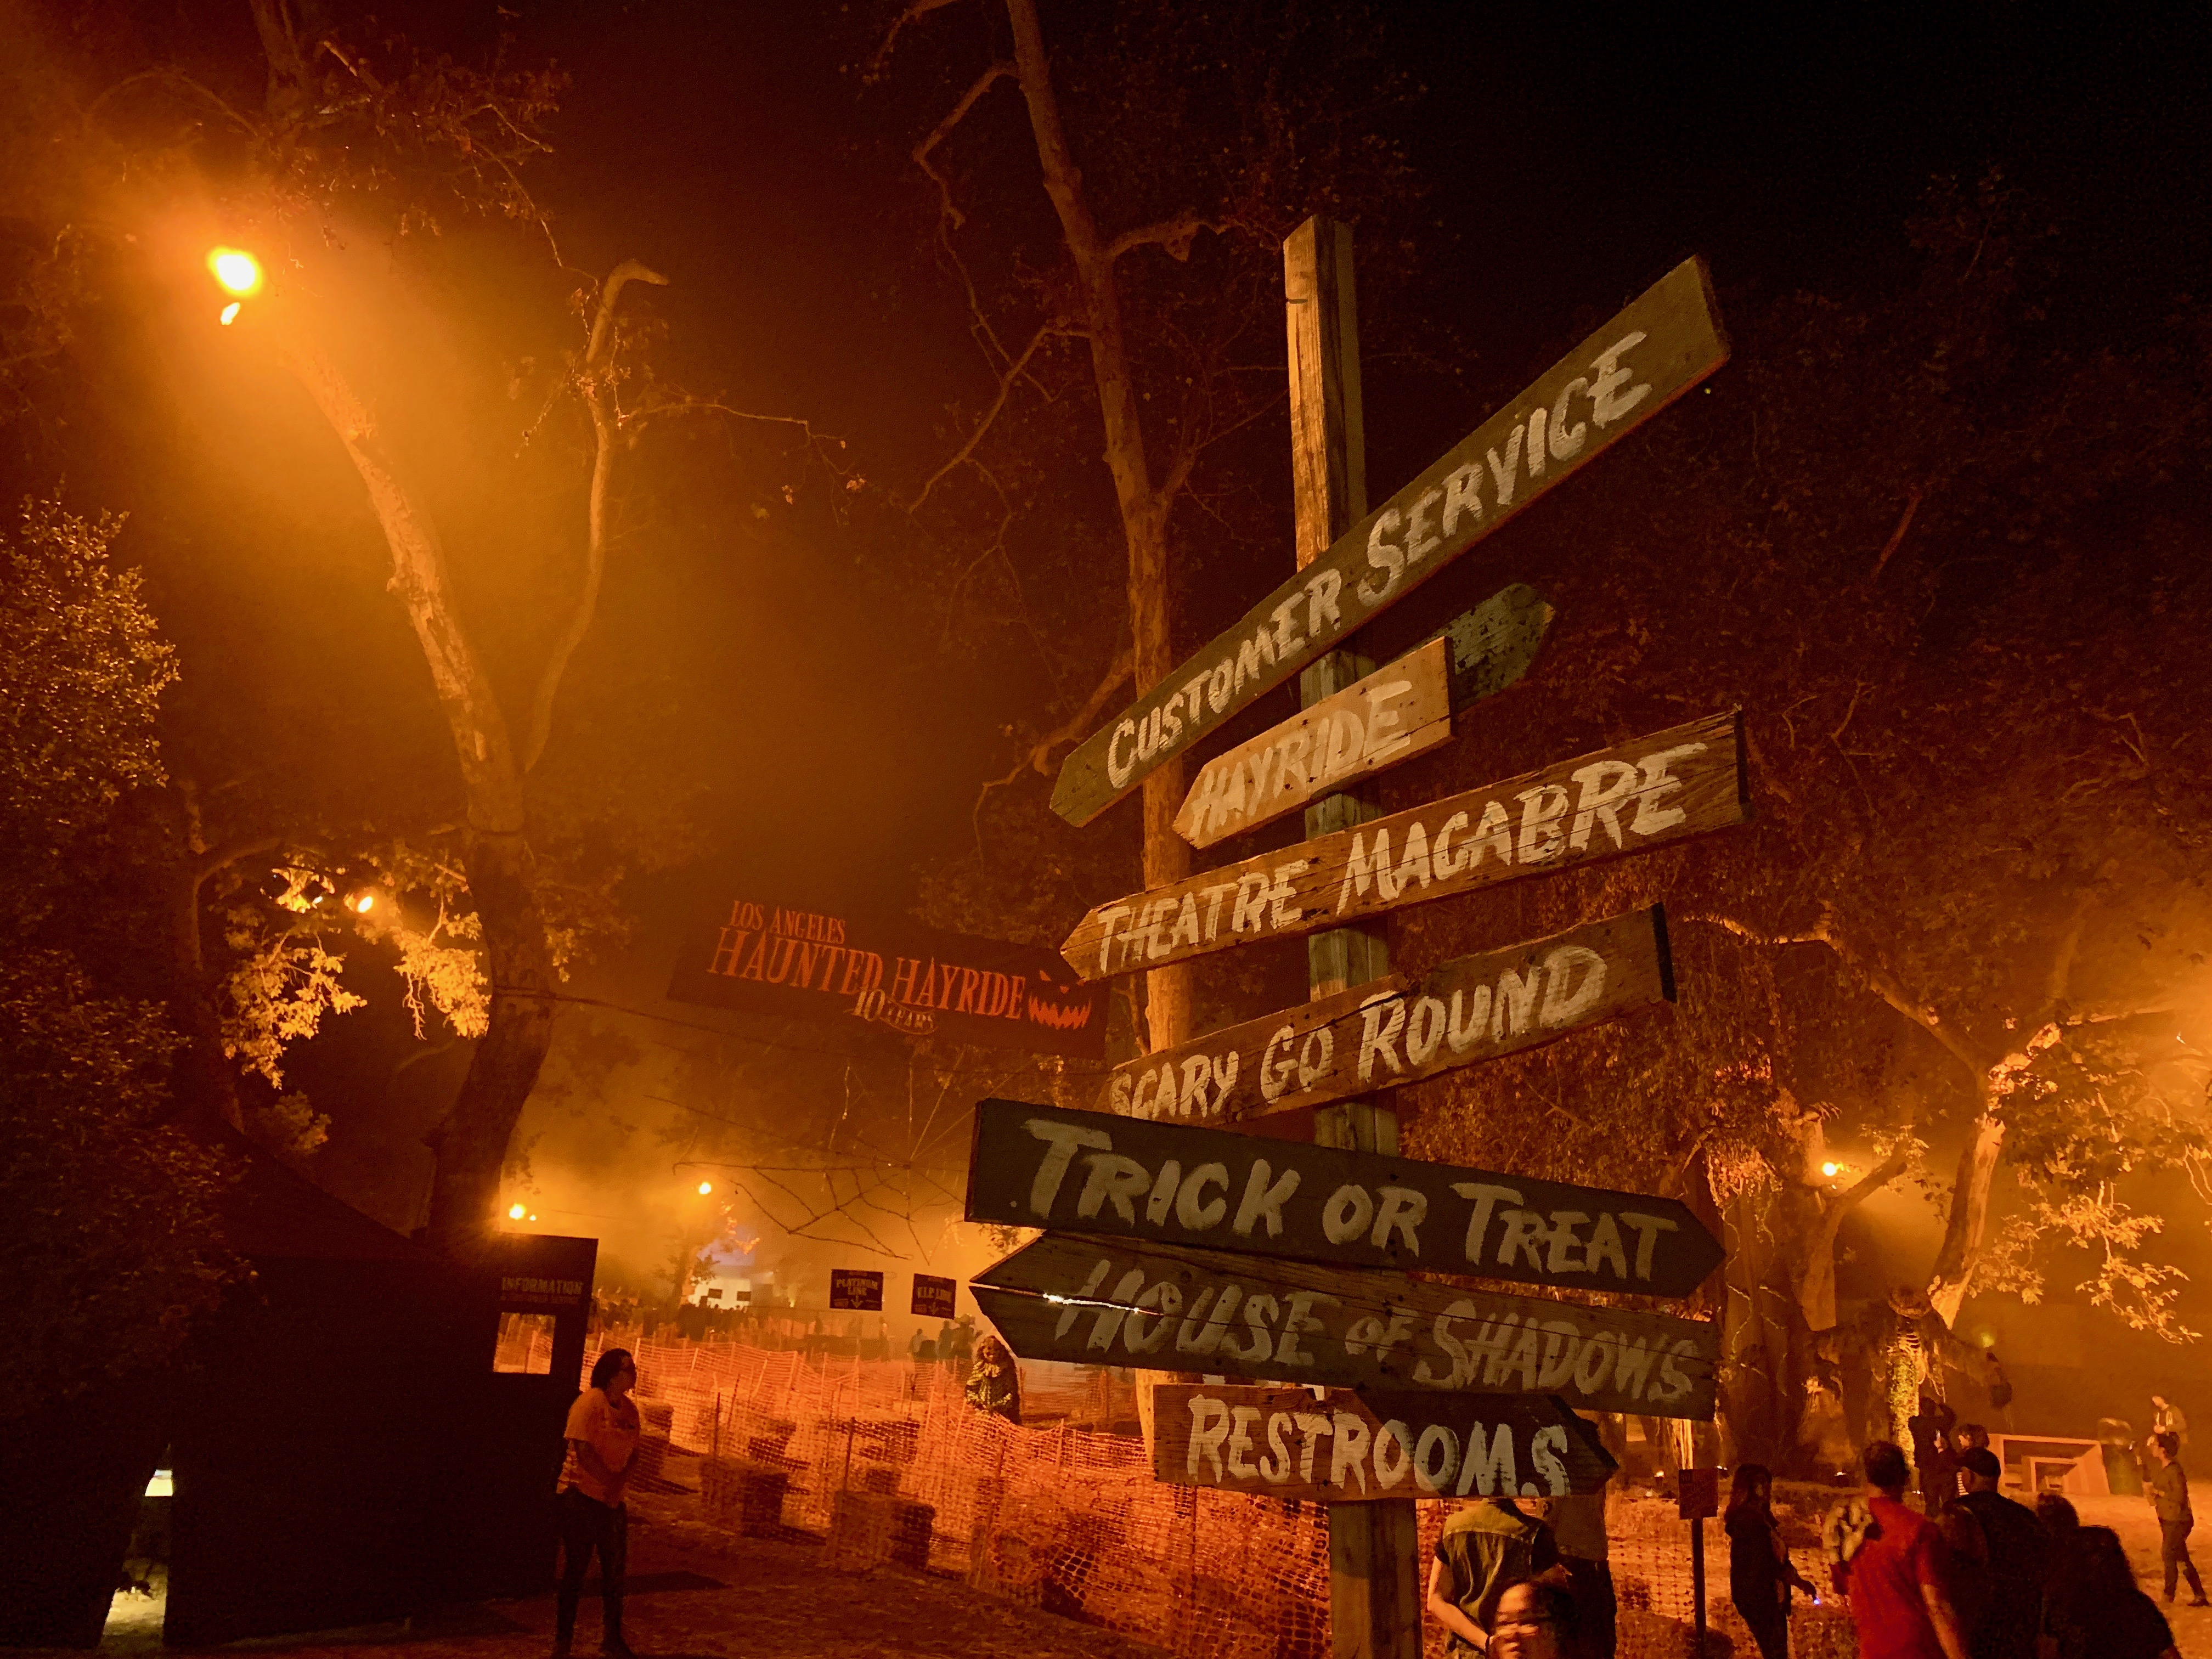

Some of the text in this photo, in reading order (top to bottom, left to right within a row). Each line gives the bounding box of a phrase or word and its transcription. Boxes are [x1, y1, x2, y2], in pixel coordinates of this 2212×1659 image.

[1107, 330, 1652, 788] CUSTOMER SERVICE
[1189, 679, 1413, 838] HAYRIDE
[730, 900, 846, 945] LOS ANGELES
[1096, 742, 1708, 974] THEATRE MACABRE
[706, 927, 1026, 1020] HAUNTED HAYRIDE
[853, 988, 886, 1022] 10
[1109, 945, 1608, 1121] SCARY GO ROUND
[1025, 1118, 1678, 1282] TRICK OR TREAT
[501, 1276, 584, 1295] INFORMATION
[1053, 1258, 1341, 1367] HOUSE
[1413, 1298, 1699, 1404] SHADOWS
[1187, 1392, 1570, 1497] RESTROOMS
